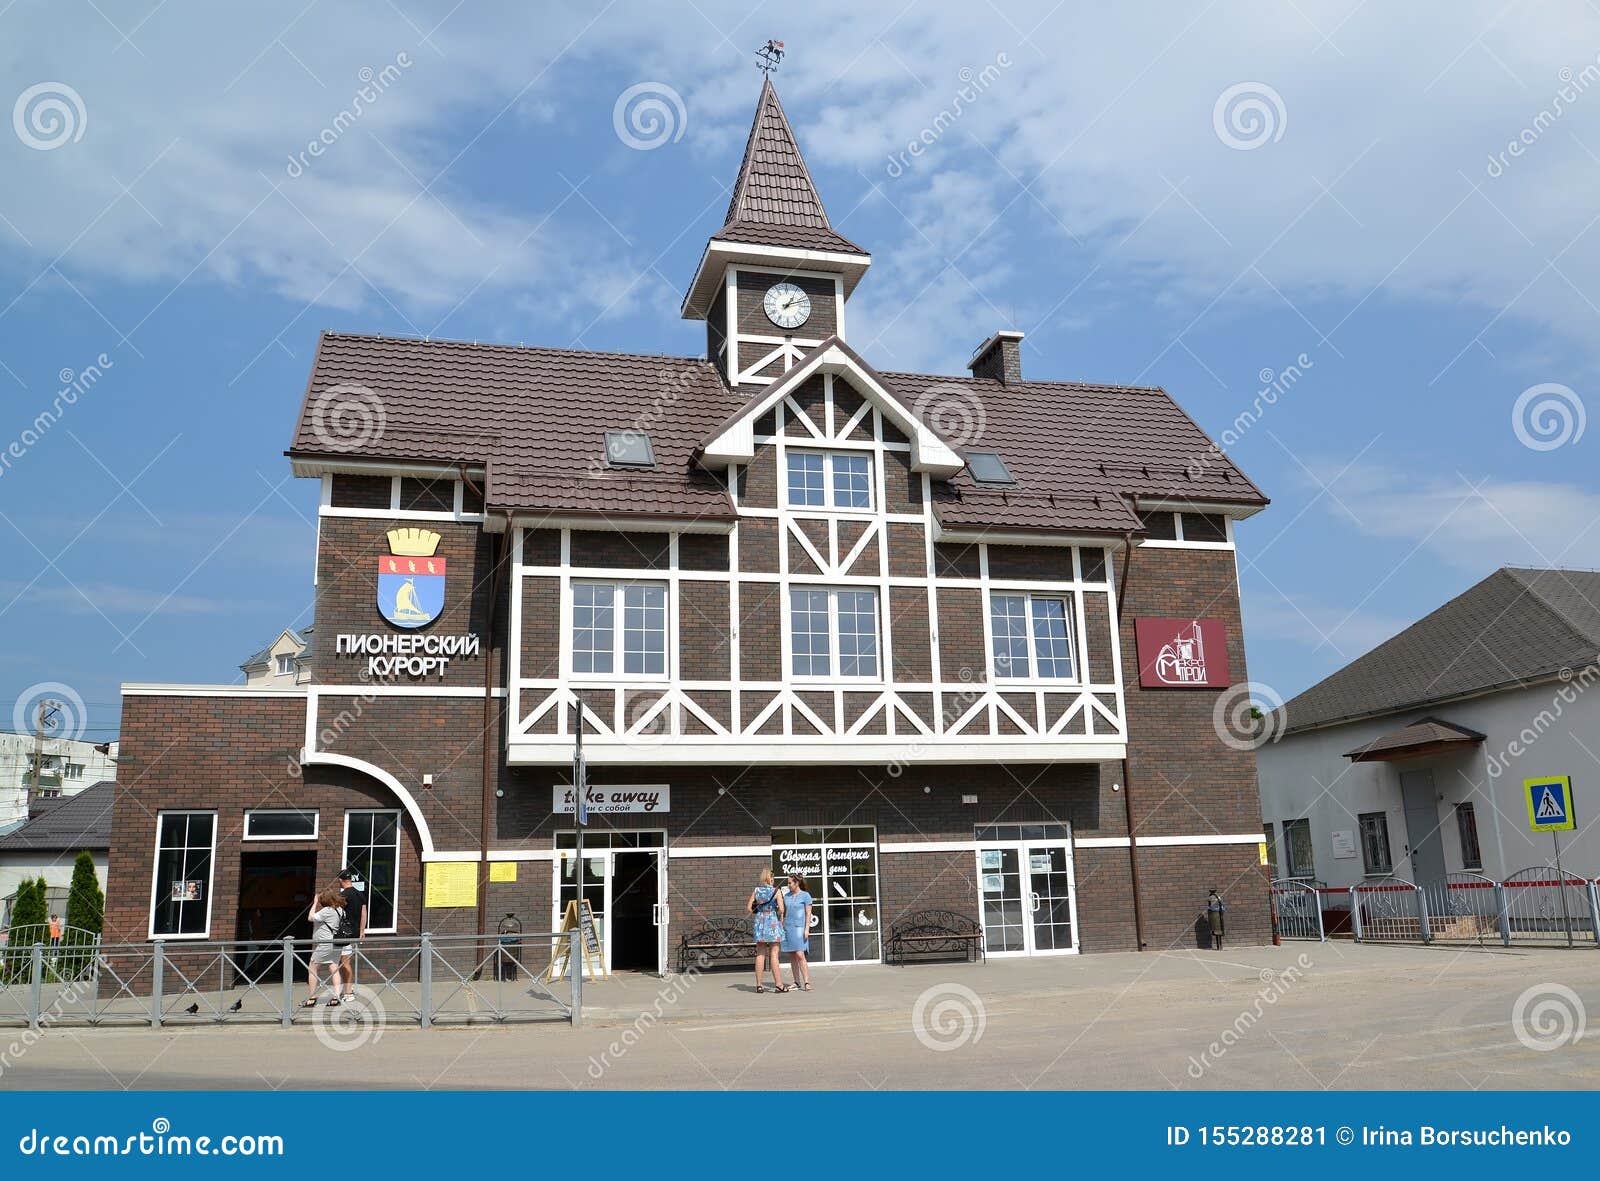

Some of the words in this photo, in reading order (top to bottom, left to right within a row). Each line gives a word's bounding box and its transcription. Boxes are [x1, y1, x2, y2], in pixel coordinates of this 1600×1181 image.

[335, 633, 480, 656] ПИОНЕРСКИЙ
[368, 656, 450, 677] КУРОРТ
[564, 786, 605, 803] tke
[610, 791, 660, 812] away
[605, 804, 631, 812] собой
[780, 849, 821, 863] Свежая
[827, 848, 870, 861] выпечка
[782, 863, 821, 876] Каждый
[829, 864, 848, 876] день
